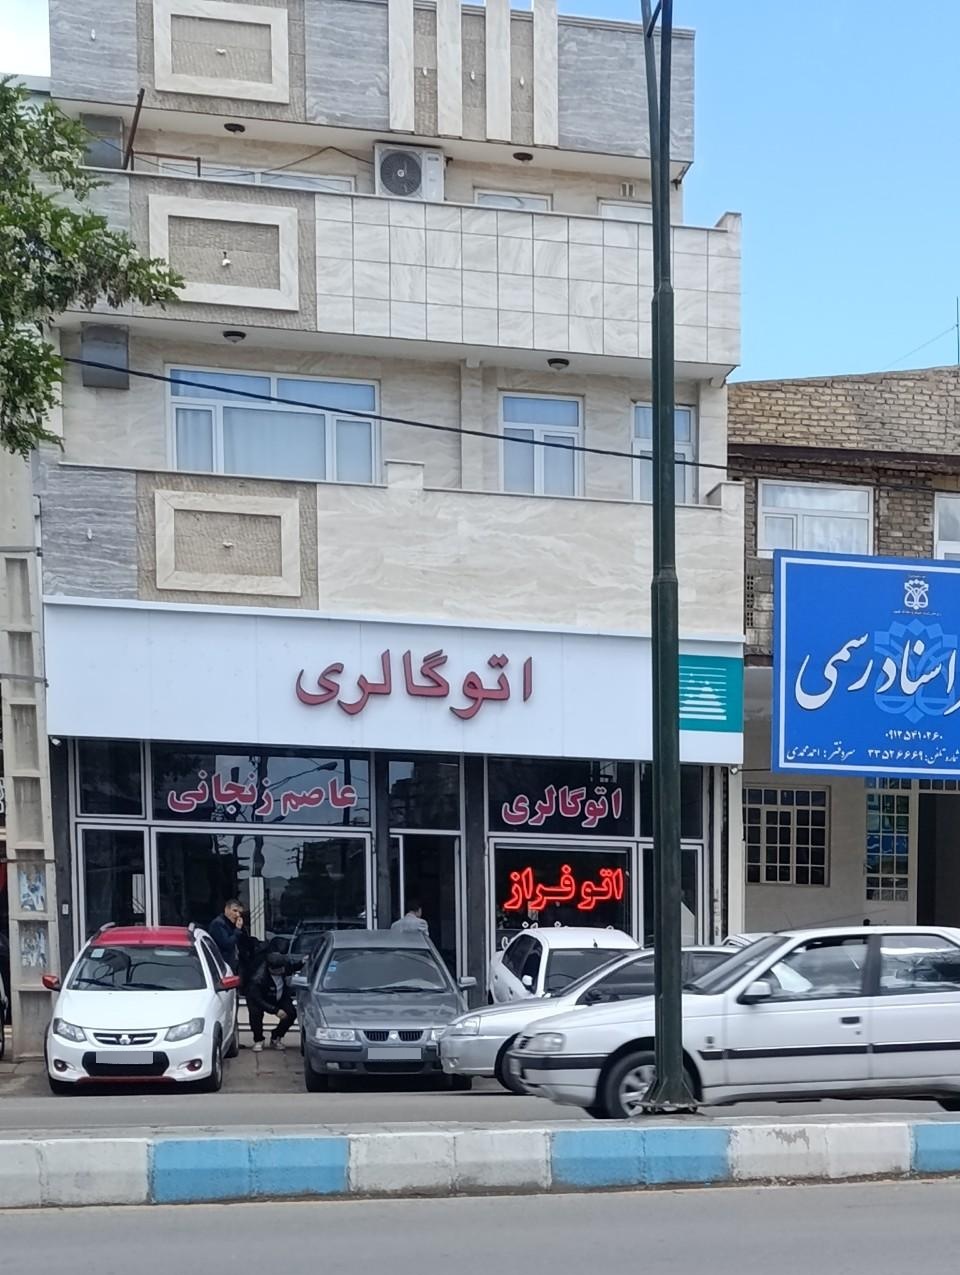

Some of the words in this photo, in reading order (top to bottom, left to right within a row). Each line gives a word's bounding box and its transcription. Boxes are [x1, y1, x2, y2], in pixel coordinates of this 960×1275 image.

[794, 632, 873, 711] رسمی
[876, 639, 957, 696] اسناد
[167, 769, 274, 817] زنجانی
[281, 776, 358, 817] عاصم
